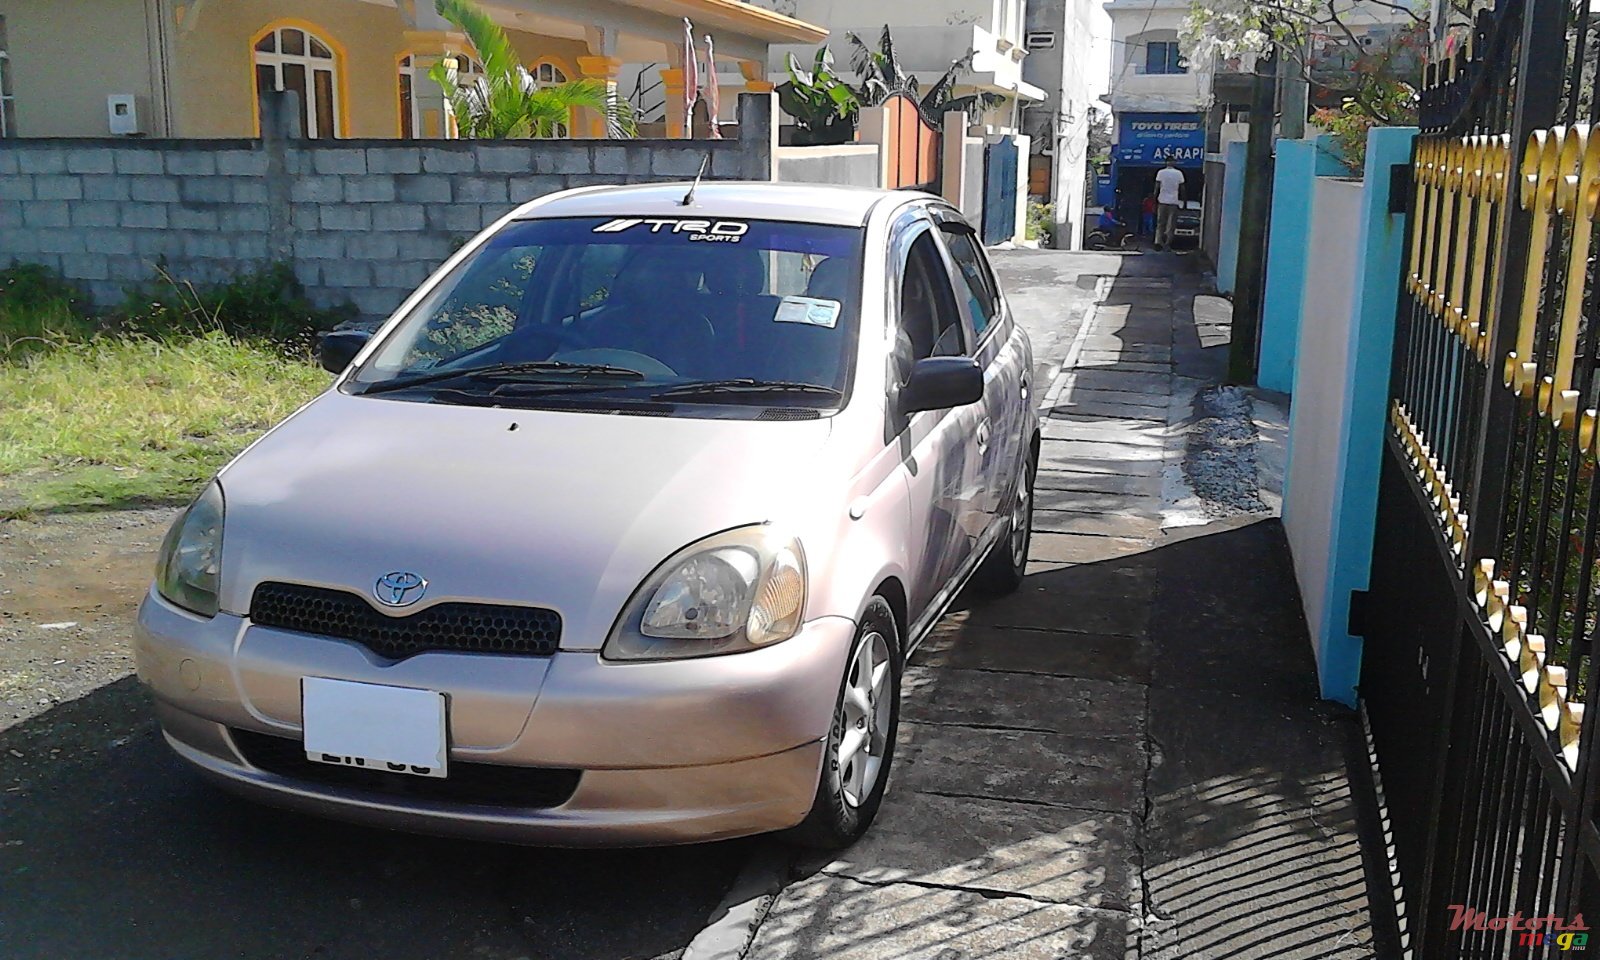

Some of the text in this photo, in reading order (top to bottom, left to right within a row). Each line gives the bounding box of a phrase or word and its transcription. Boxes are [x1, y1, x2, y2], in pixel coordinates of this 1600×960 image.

[1131, 122, 1199, 131] TOYO TIRES
[644, 219, 749, 235] TRD
[689, 234, 741, 243] SPORTS
